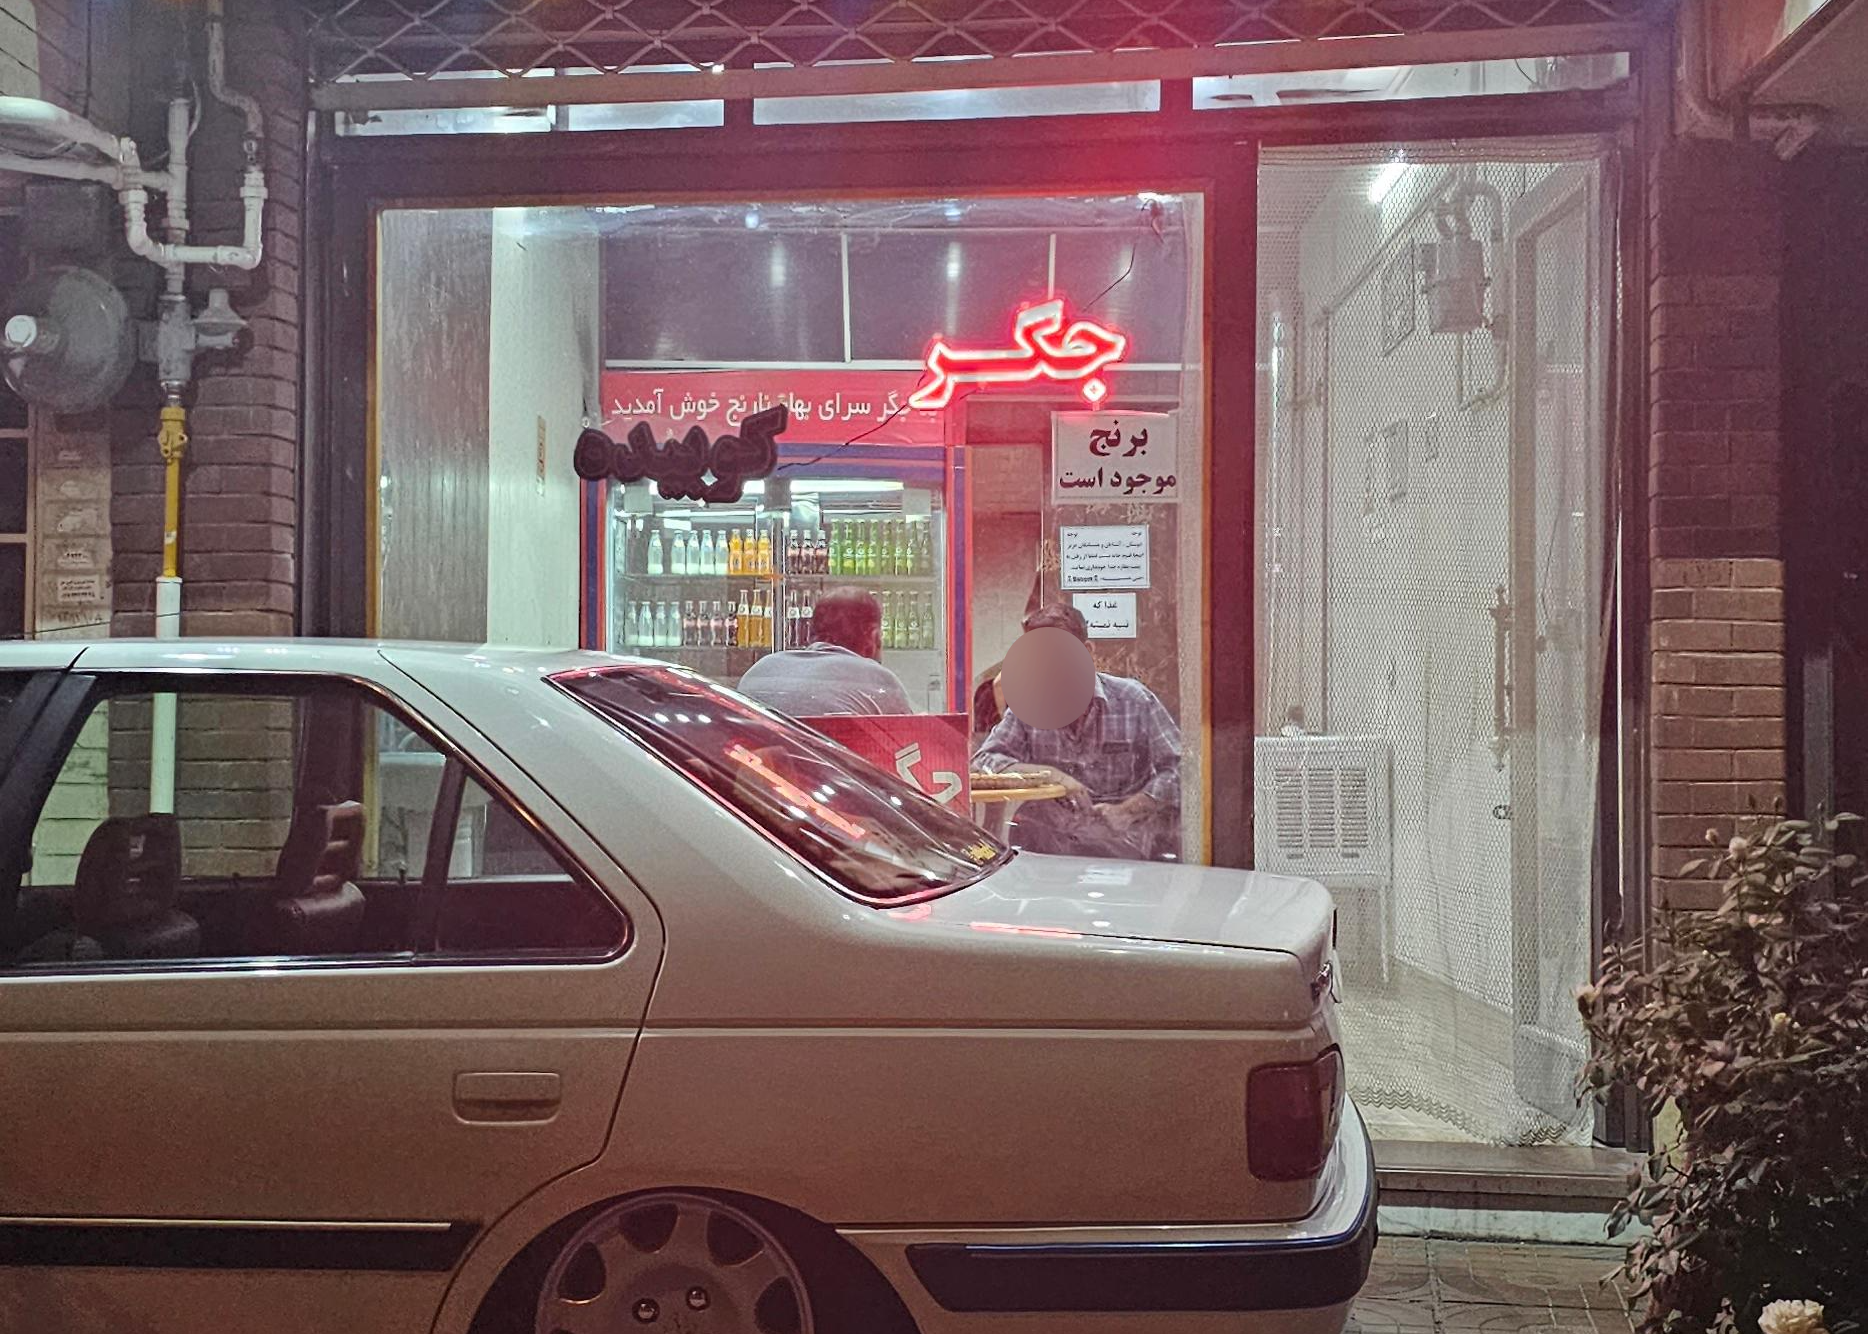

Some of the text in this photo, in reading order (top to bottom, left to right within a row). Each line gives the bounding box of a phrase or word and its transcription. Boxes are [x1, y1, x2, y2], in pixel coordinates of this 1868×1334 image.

[906, 298, 1128, 410] جگر
[611, 388, 664, 420] آمدید
[669, 391, 721, 420] خوش
[818, 392, 871, 422] سرای
[1089, 419, 1148, 457] برنج
[1059, 466, 1177, 495] موجود است
